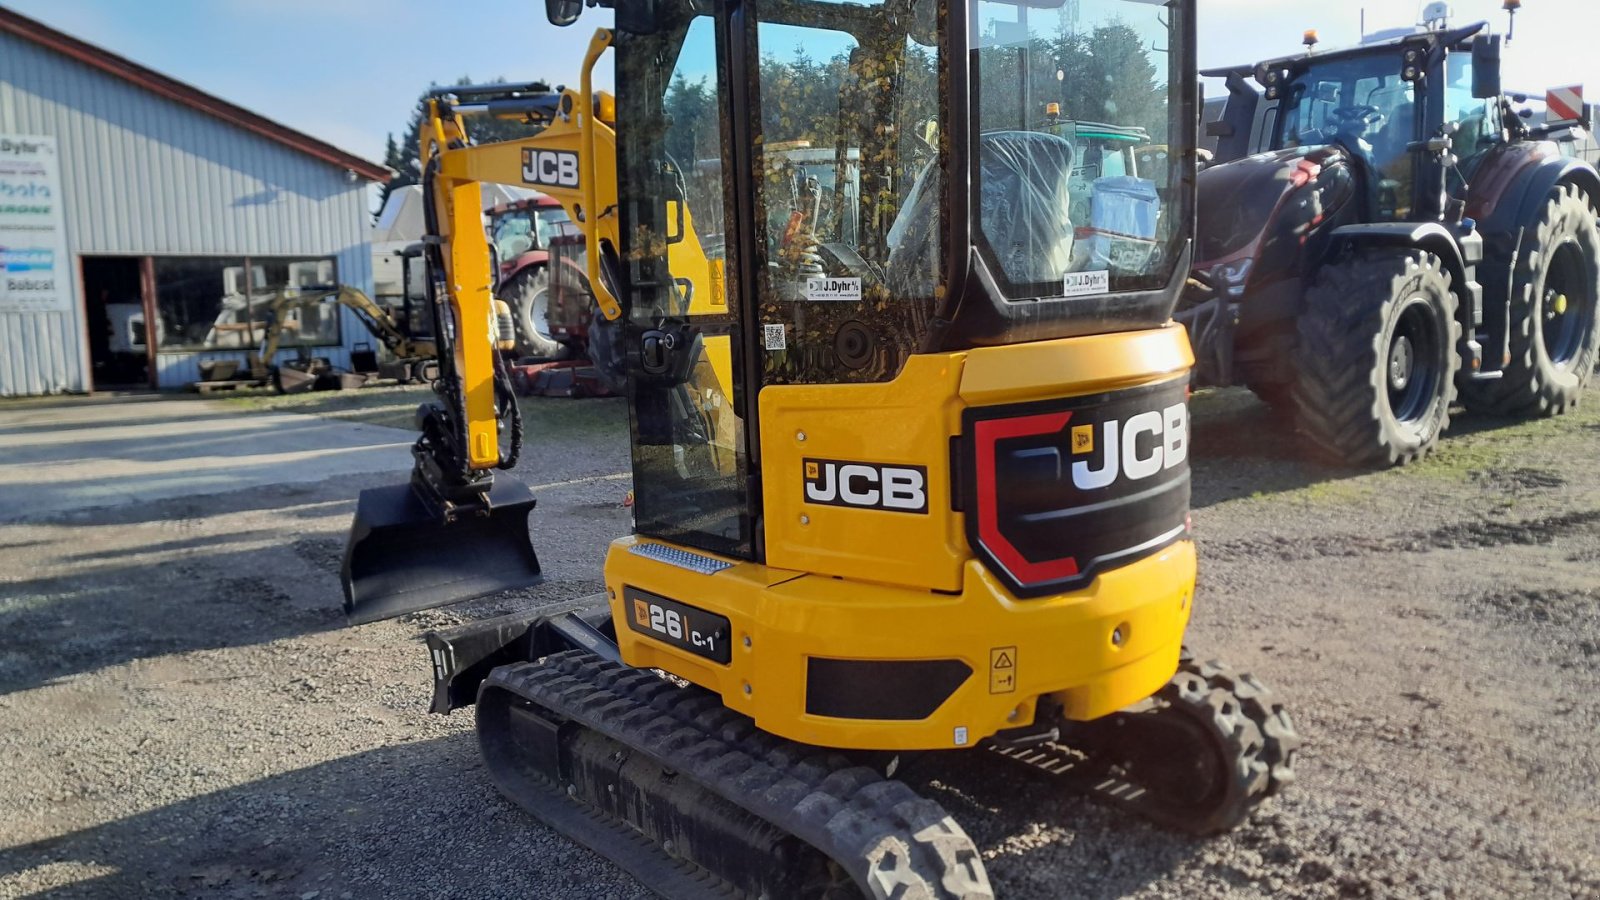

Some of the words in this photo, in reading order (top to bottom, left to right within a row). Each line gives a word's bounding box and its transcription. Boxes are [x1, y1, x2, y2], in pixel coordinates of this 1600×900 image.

[523, 151, 579, 186] JCB
[823, 280, 851, 293] J.Dyhr
[1078, 274, 1100, 287] J.Dyhr
[1071, 402, 1187, 490] JCB
[806, 463, 926, 510] JCB
[650, 604, 682, 639] 26
[691, 630, 714, 651] C-1
